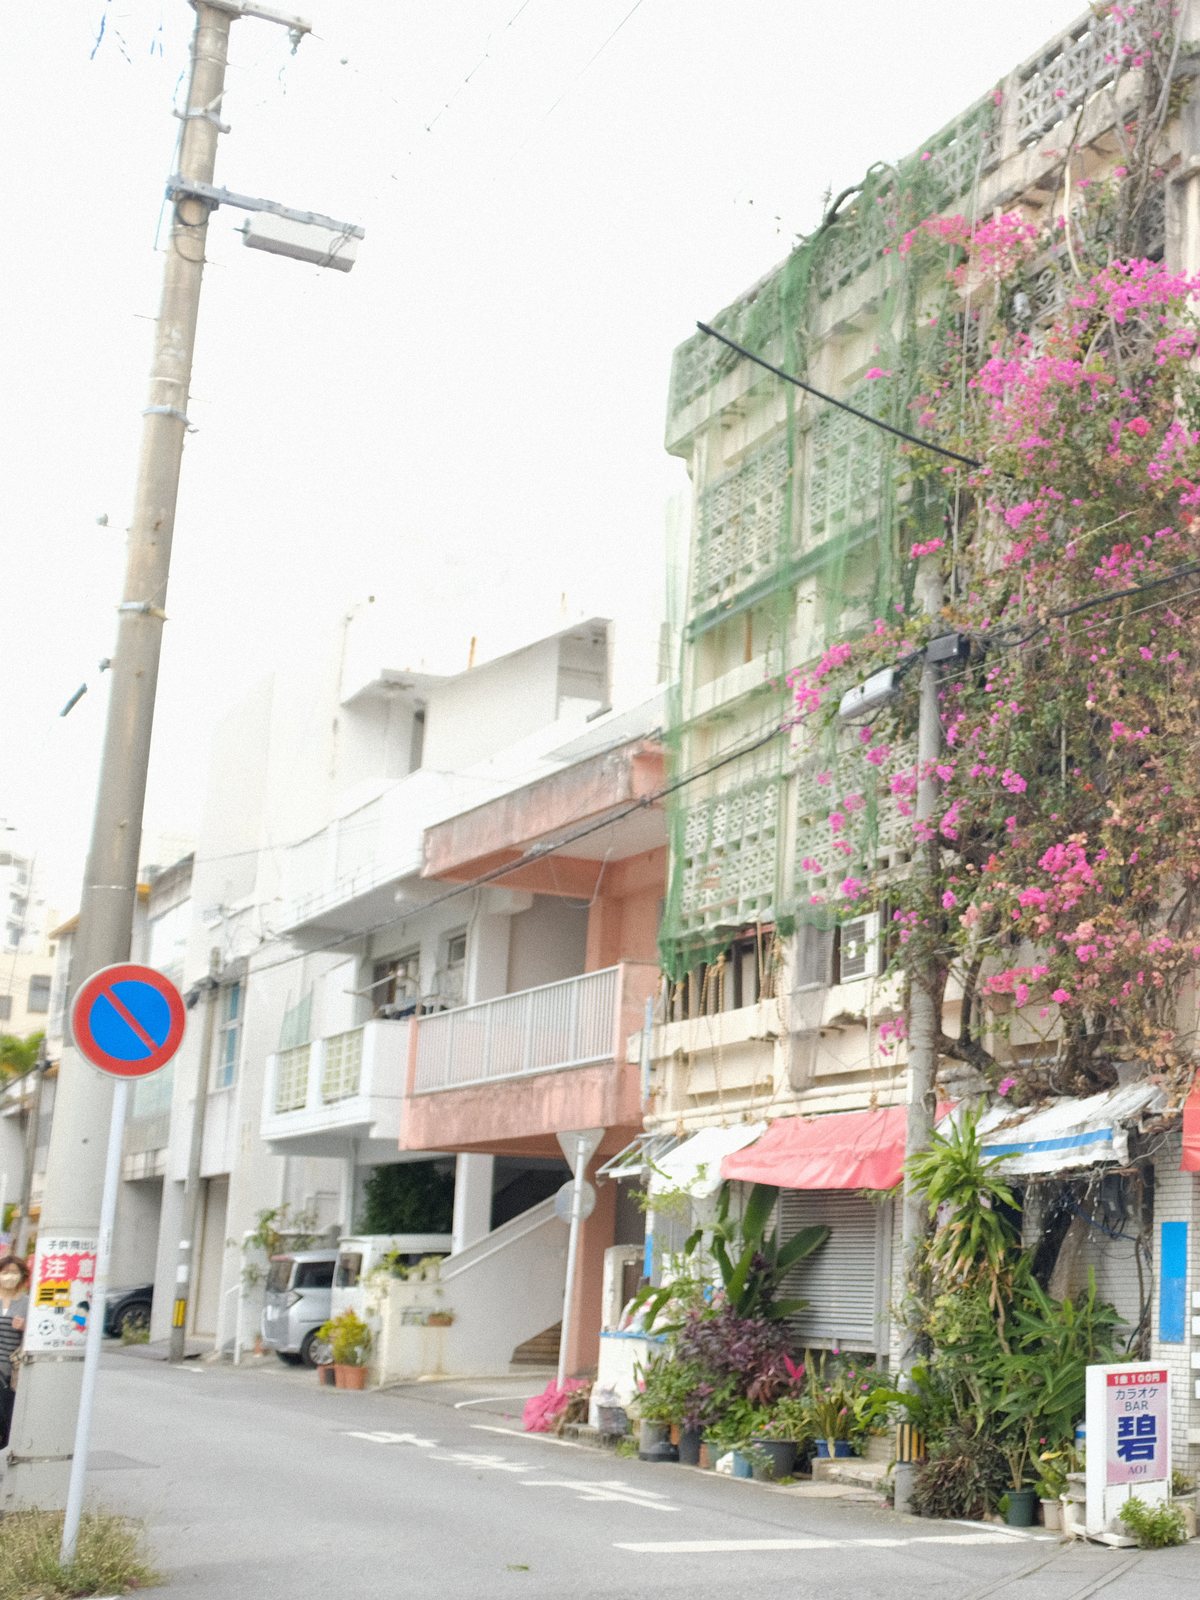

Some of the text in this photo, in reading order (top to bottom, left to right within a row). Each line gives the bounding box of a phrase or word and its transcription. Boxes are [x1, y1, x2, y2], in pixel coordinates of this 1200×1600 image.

[1115, 1387, 1159, 1400] カラオケ
[1125, 1400, 1149, 1412] BAR
[1117, 1414, 1157, 1462] 碧
[1128, 1464, 1148, 1475] AOI
